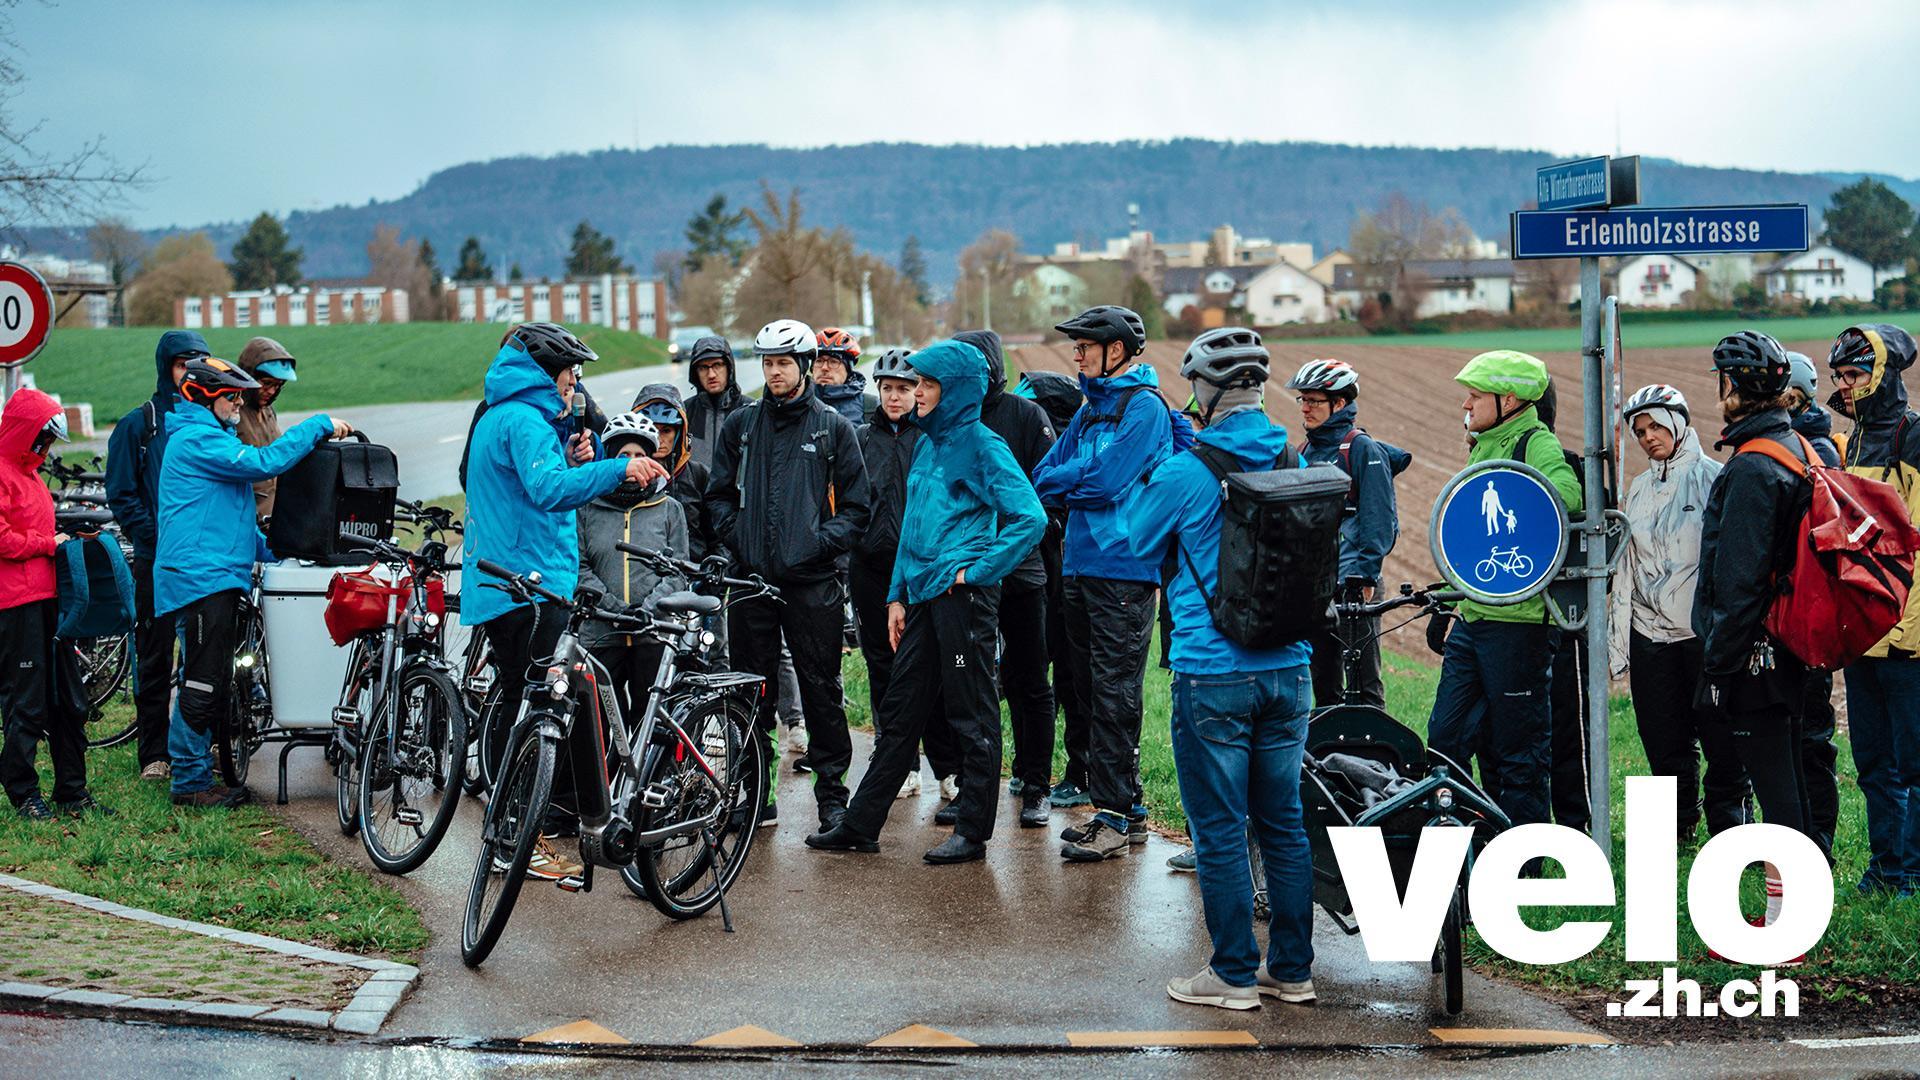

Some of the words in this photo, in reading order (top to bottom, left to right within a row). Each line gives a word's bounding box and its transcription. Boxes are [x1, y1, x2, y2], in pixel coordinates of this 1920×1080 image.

[1565, 216, 1760, 246] Erlenholzstrasse
[0, 295, 21, 331] 0
[339, 520, 378, 537] MIPRO
